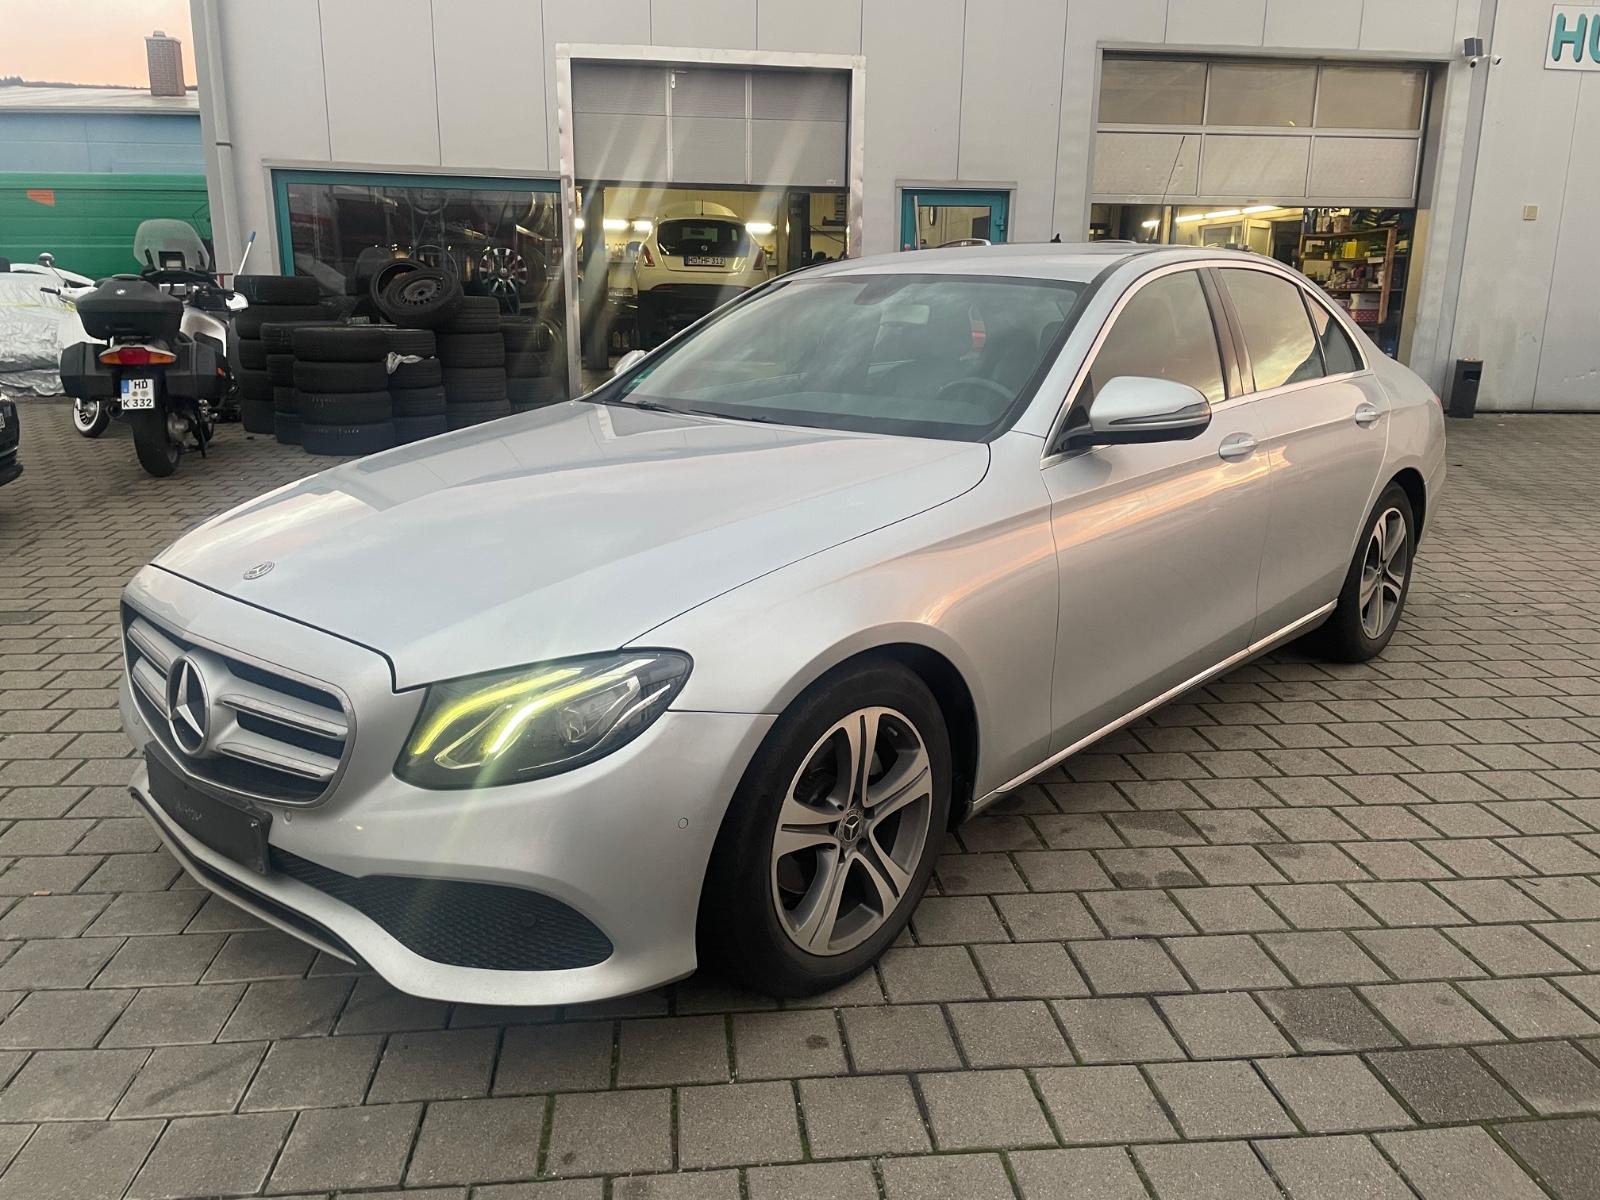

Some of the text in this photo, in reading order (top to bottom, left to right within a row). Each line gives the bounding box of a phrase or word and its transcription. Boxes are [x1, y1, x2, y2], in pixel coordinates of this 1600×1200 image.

[711, 257, 724, 265] 312
[134, 380, 148, 389] HD
[123, 398, 152, 408] K 332
